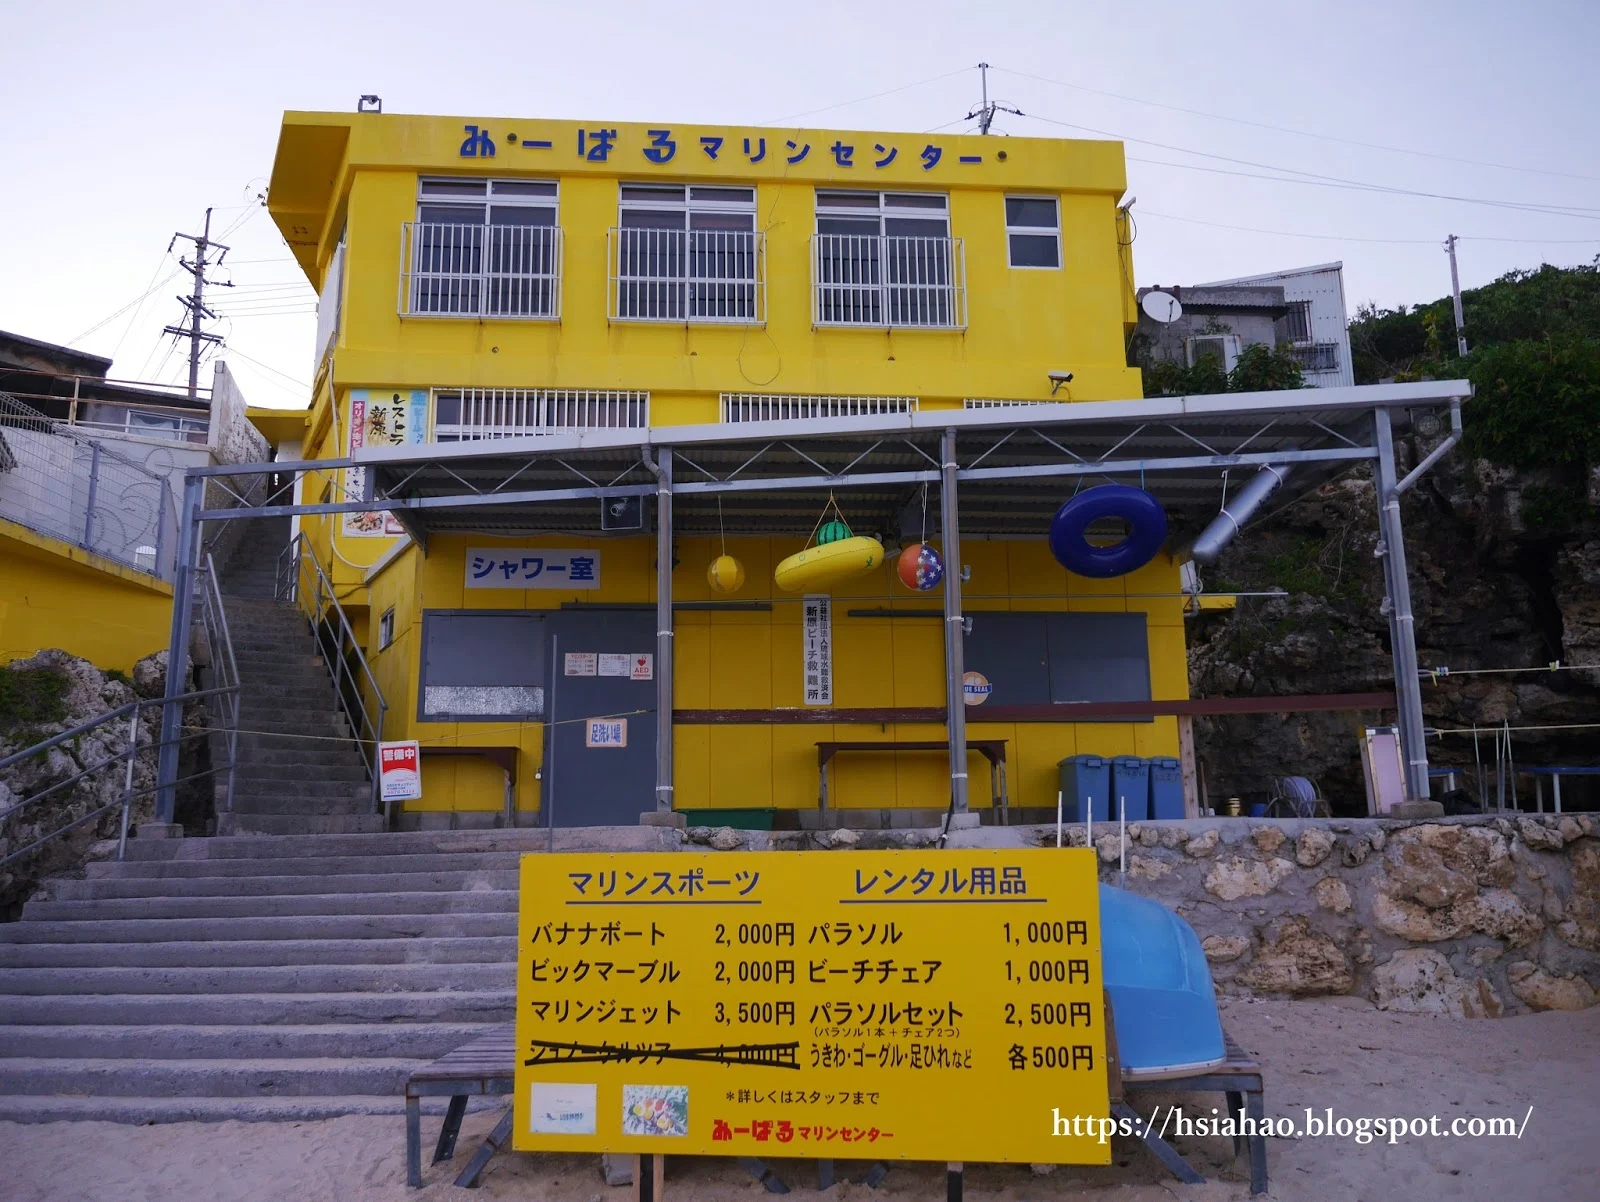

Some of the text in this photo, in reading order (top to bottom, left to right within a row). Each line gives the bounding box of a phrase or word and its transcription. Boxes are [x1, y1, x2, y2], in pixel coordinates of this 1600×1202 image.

[460, 125, 983, 164] みーばるマリンセンター
[390, 393, 406, 446] レストラ
[472, 557, 594, 580] シャワー室
[806, 606, 819, 700] 新原ビーチ救難所
[569, 867, 760, 896] マリンスポーツ
[856, 867, 1027, 895] レンタル用品
[532, 921, 795, 946] バナナボート 2,000円
[808, 921, 1088, 946] パラソル 1,000円
[531, 958, 795, 984] ビックマーブル 2,000円
[809, 959, 1090, 984] ビーチチェア 1,000円
[531, 1000, 795, 1026] マリンジェット 3,500円
[809, 1002, 1091, 1028] パラソルセット 2,500円
[530, 1041, 690, 1065] シュノーケルツア
[1008, 1044, 1094, 1071] 各500円
